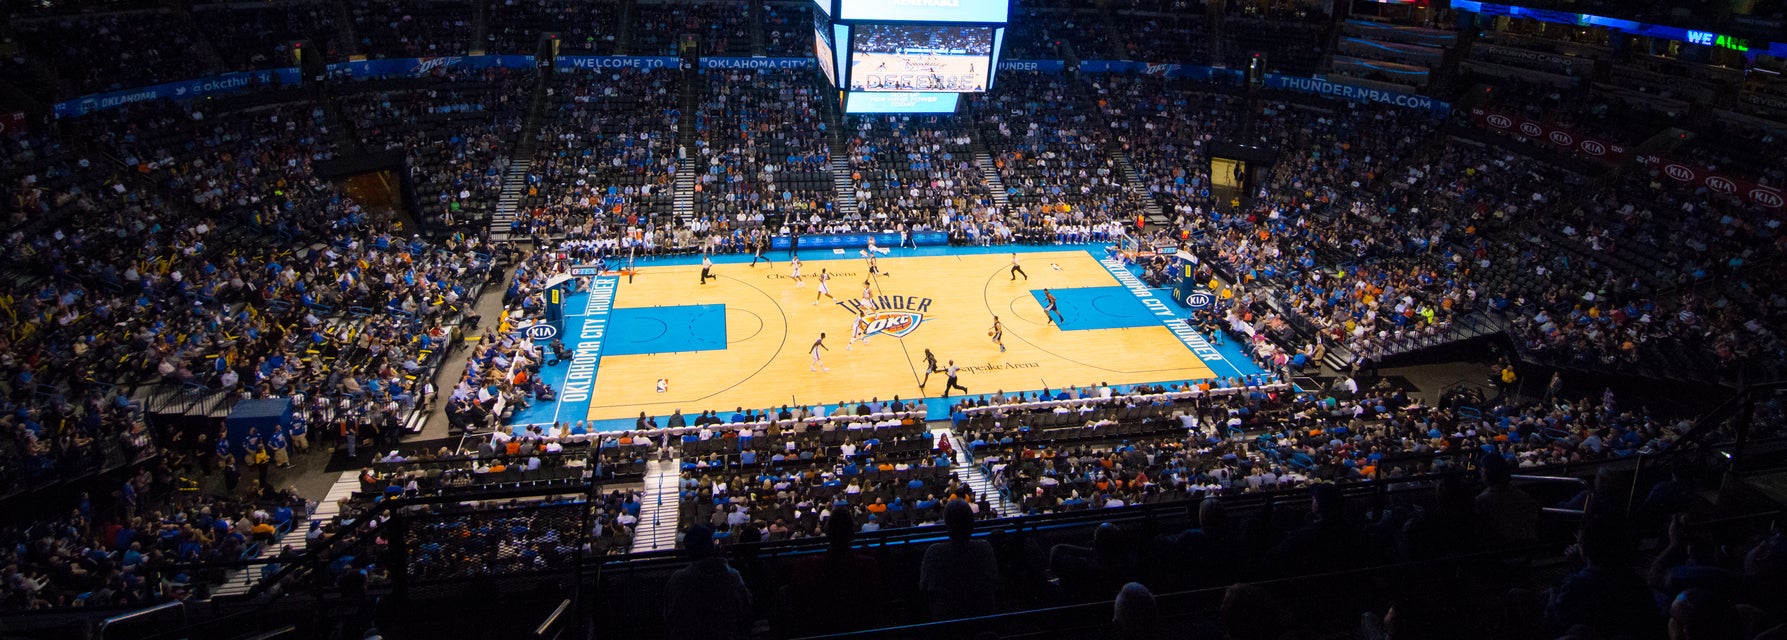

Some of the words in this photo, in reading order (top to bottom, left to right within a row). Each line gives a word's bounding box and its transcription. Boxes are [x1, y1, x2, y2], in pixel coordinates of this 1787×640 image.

[1688, 30, 1713, 45] WE
[573, 58, 640, 68] WELCOME
[646, 58, 664, 68] TO
[708, 59, 776, 69] OKLAHOMA
[780, 59, 806, 69] CITY
[999, 62, 1037, 70] UNDER
[101, 91, 157, 108] OKLAHOMA
[1280, 77, 1432, 109] THUNDER.NBA.COM
[587, 278, 616, 317] THUNDER
[1189, 296, 1206, 305] KIA
[531, 327, 552, 337] KIA
[580, 319, 606, 339] CITY
[866, 315, 909, 335] OKC
[1142, 298, 1175, 316] CITY
[1163, 318, 1223, 361] THUNDER
[563, 341, 600, 402] OKLAHOMA
[1005, 361, 1040, 370] Arena
